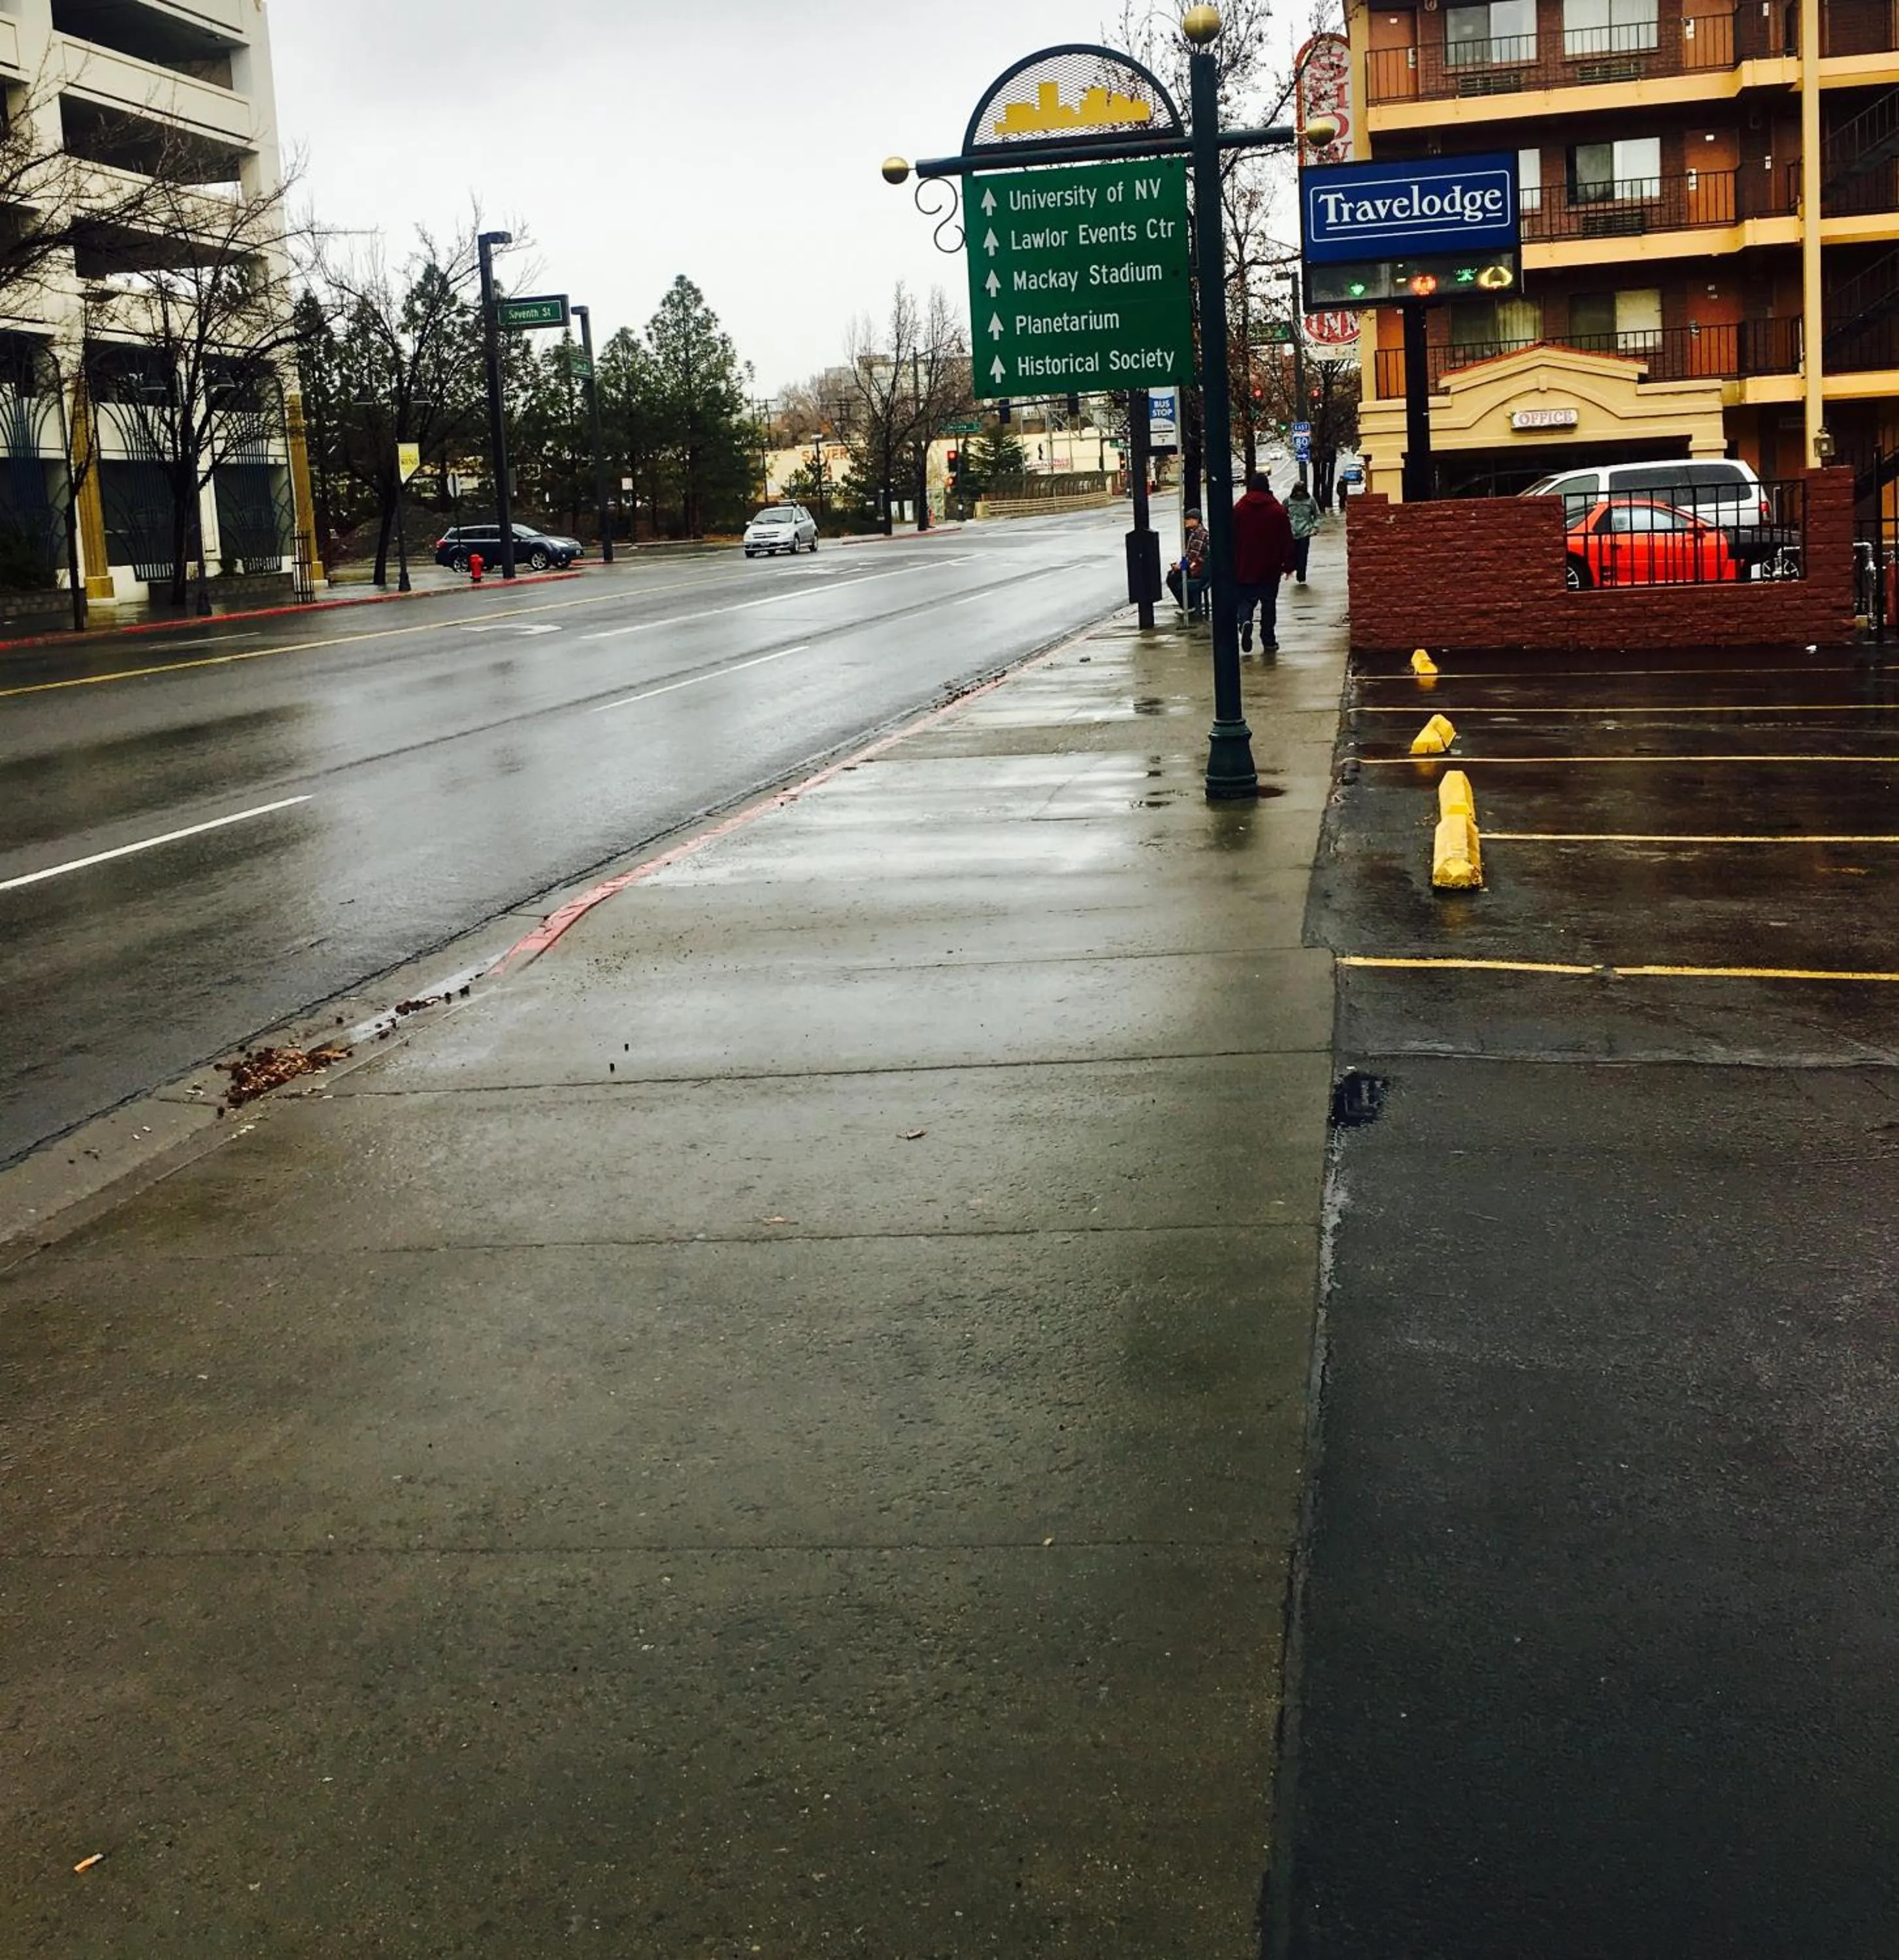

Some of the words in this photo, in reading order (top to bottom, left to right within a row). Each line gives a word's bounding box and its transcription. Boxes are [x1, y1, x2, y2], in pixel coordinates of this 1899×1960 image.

[1010, 185, 1097, 210] University
[1107, 181, 1123, 203] of
[1134, 178, 1161, 200] NV
[1318, 185, 1502, 221] Travelodge
[1011, 228, 1068, 250] Lawlor
[1078, 221, 1136, 244] Events
[1146, 218, 1175, 238] Ctr
[1014, 269, 1078, 291] Mackay
[1089, 262, 1162, 285] Stadium
[509, 308, 539, 319] Seventh
[542, 306, 551, 317] St
[1016, 310, 1119, 335] Planetarium
[1017, 351, 1099, 376] Historical
[1109, 348, 1174, 372] Society
[1152, 408, 1173, 417] STOP
[1153, 399, 1170, 408] BUS
[1519, 411, 1573, 425] OFFICE
[1296, 437, 1308, 449] 80
